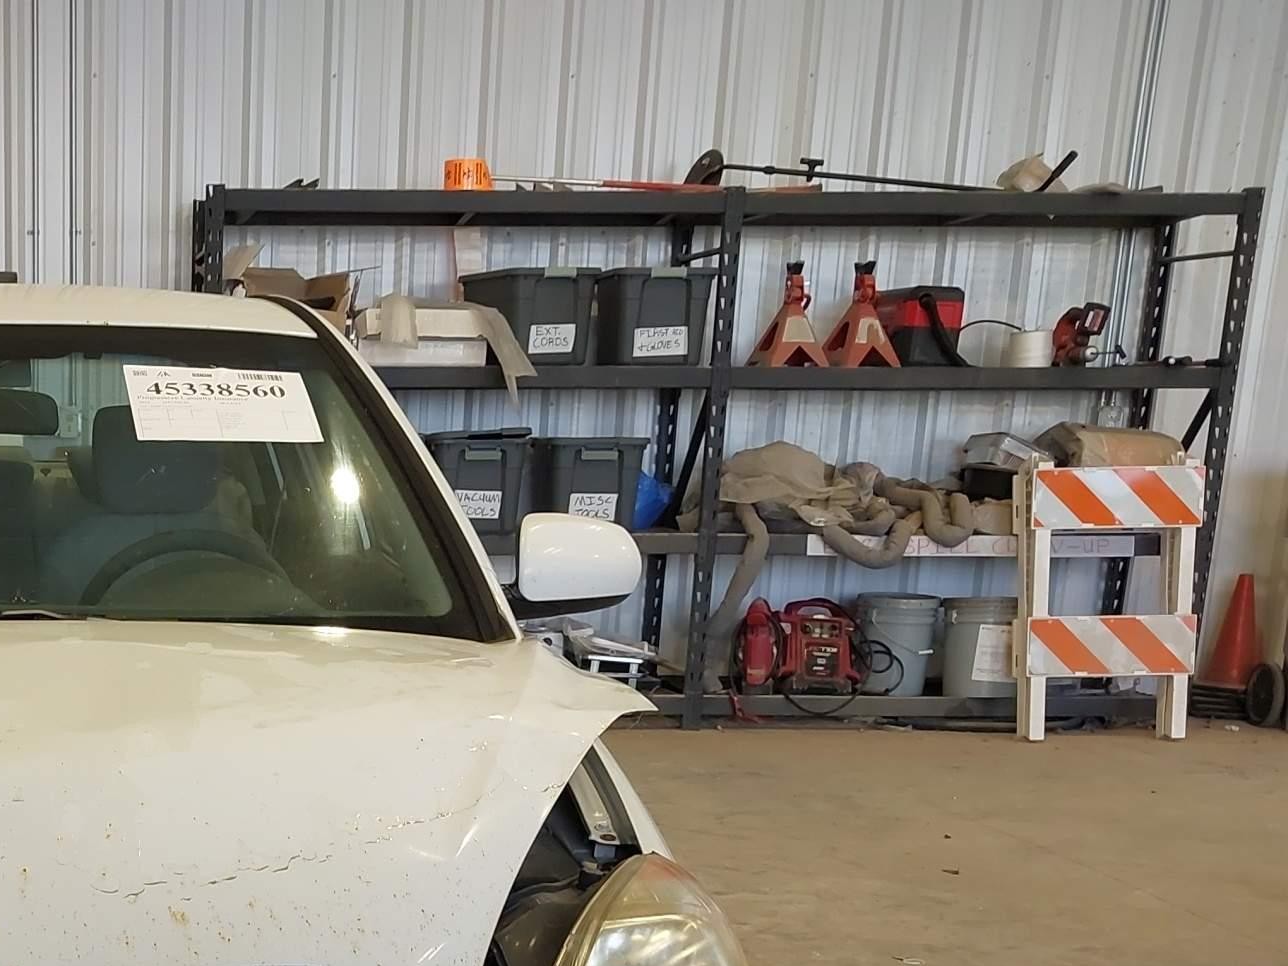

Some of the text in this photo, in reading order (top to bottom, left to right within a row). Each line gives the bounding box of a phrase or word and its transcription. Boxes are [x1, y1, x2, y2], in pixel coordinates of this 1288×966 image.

[535, 326, 561, 336] EXT.
[532, 336, 569, 349] CORDS
[146, 381, 287, 399] 45338560
[455, 492, 500, 503] VACUUM
[574, 495, 613, 506] MISC
